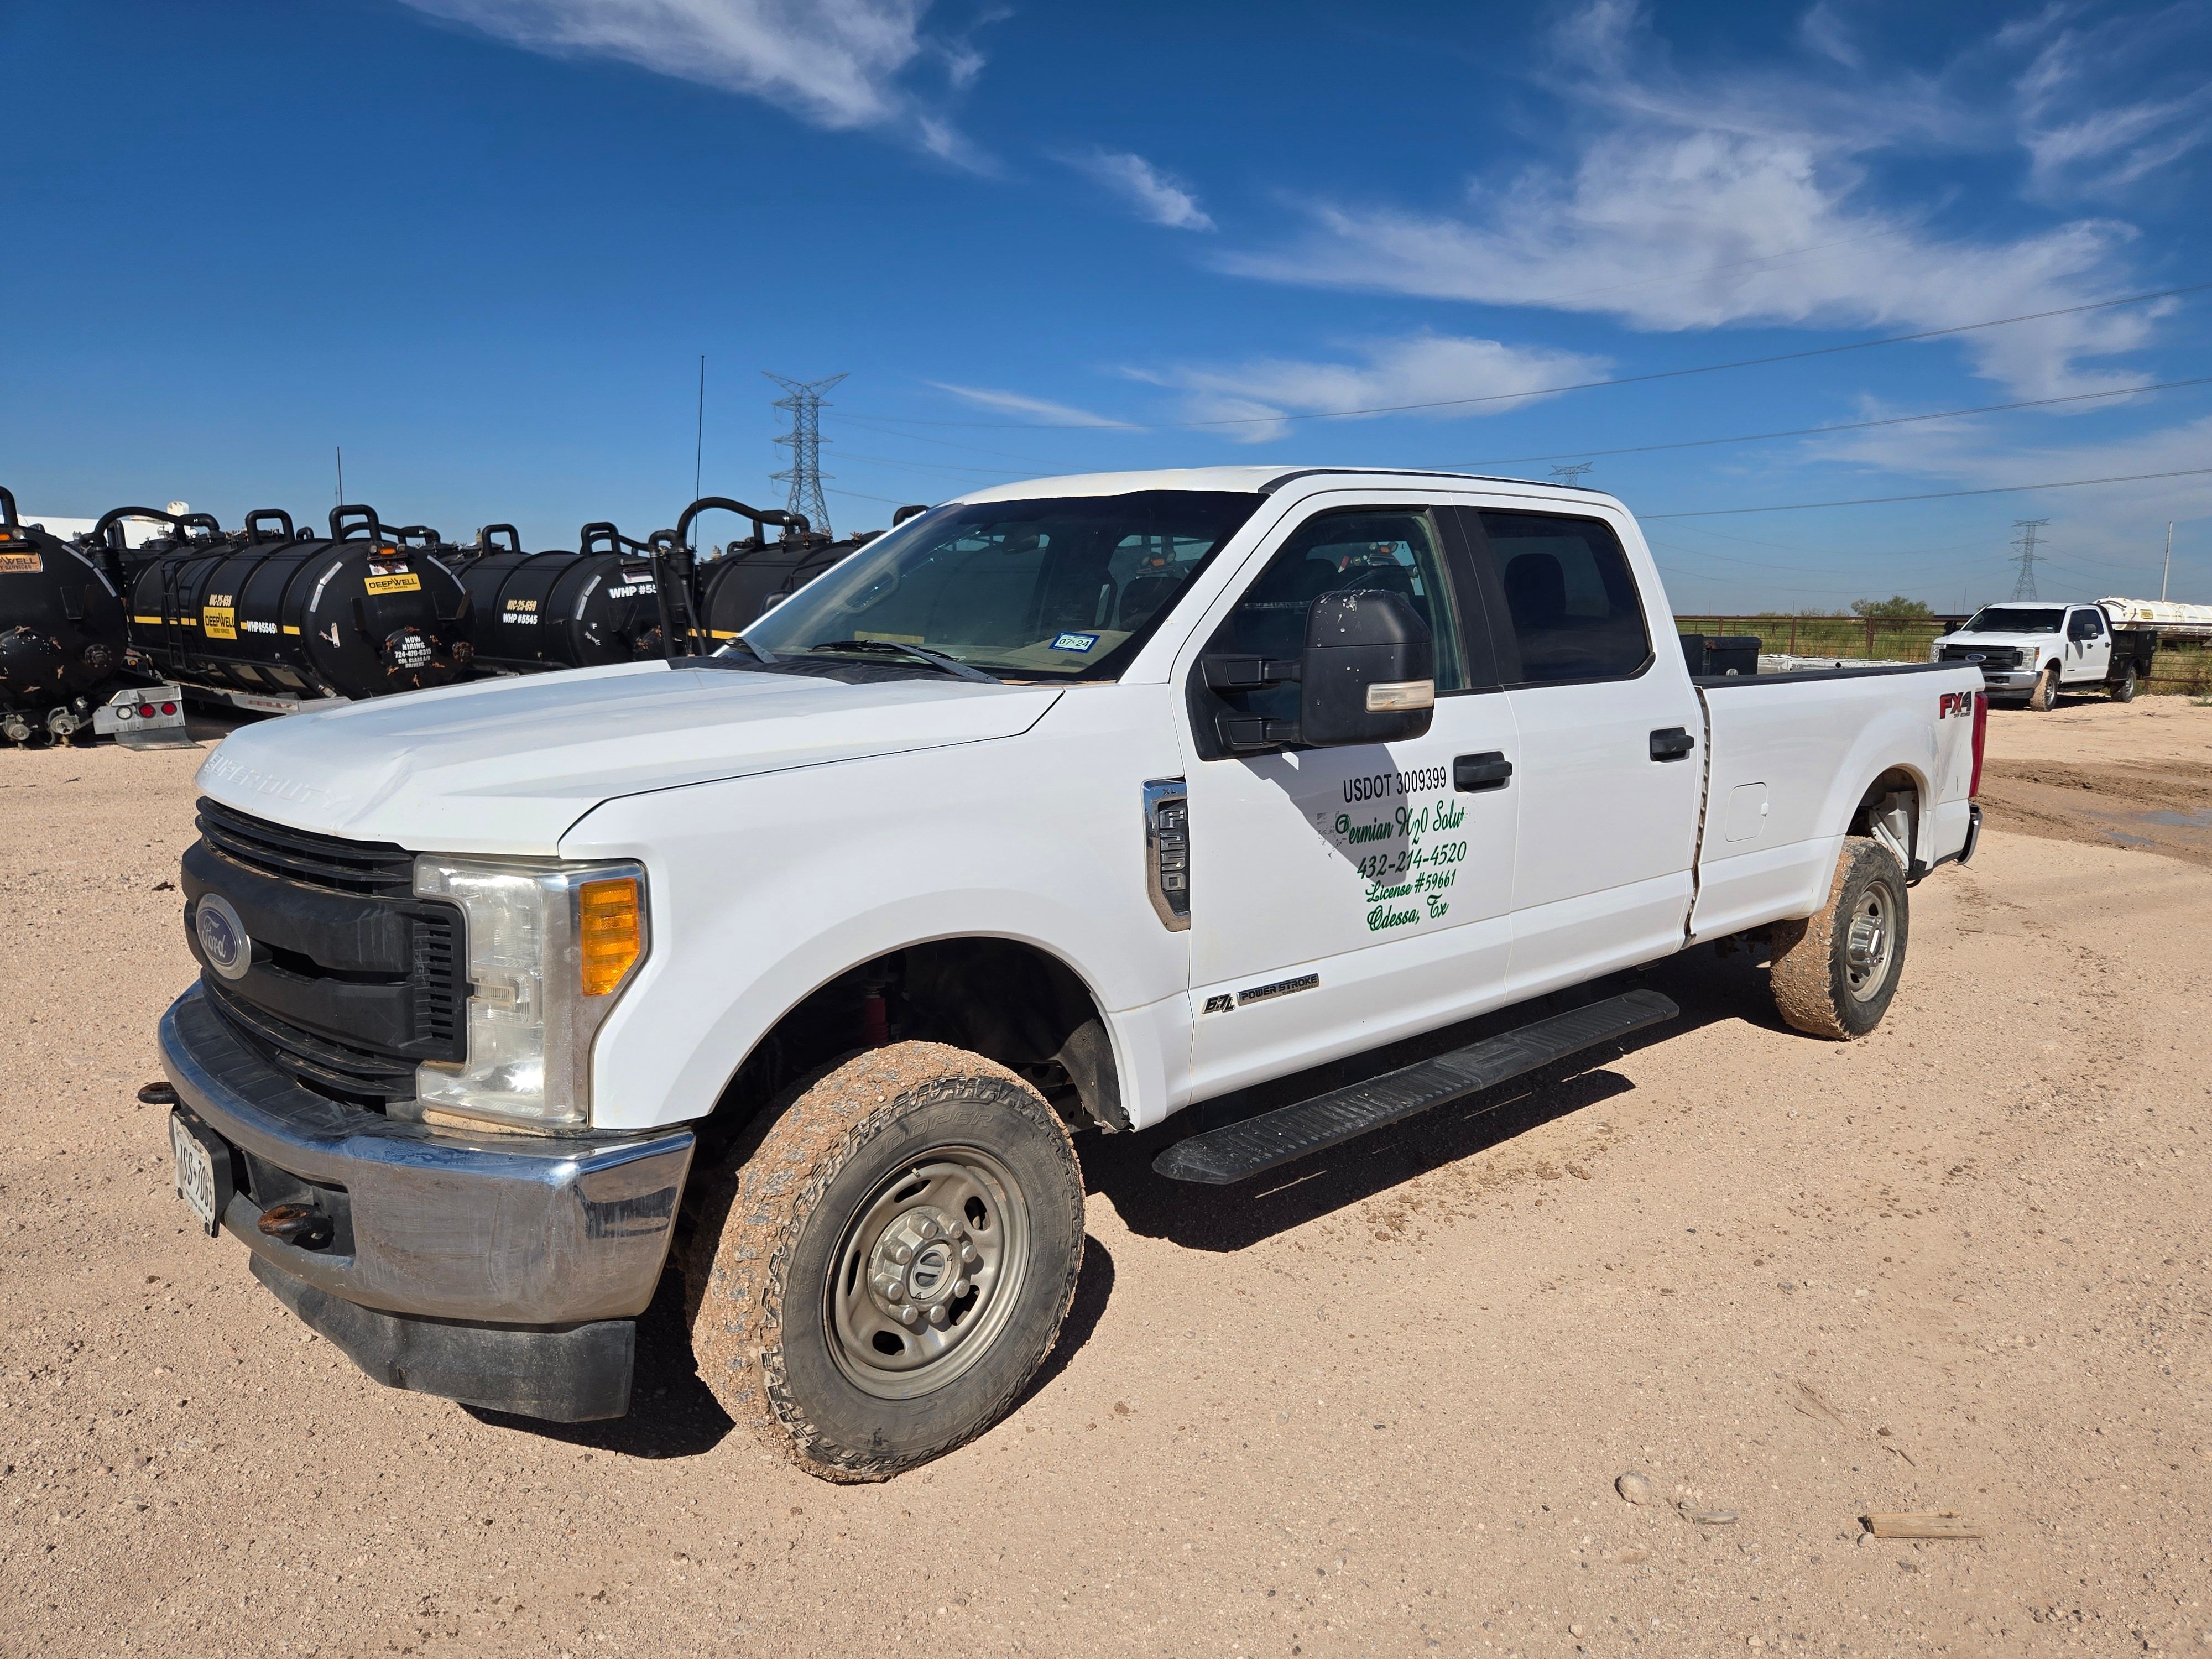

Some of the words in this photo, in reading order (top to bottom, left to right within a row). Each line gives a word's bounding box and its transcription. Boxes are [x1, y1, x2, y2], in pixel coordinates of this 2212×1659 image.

[369, 578, 418, 589] DEEPWELL
[609, 586, 637, 599] WHP
[205, 612, 235, 628] DEEPWELL
[503, 612, 518, 624] WHP
[518, 614, 538, 625] #5545
[402, 641, 425, 650] HIRING
[1939, 691, 1972, 719] FX4
[1343, 774, 1392, 803] USDOT
[1396, 766, 1447, 795] 3009399
[1357, 841, 1467, 879] 432-214-4520
[1365, 880, 1413, 902] License
[1415, 868, 1457, 894] #59661
[1367, 904, 1420, 932] Odessa,
[1427, 893, 1449, 919] Tx
[202, 915, 226, 958] Ford
[1241, 986, 1277, 1001] POWER
[1279, 975, 1317, 992] STROKE
[865, 1110, 994, 1171] COOPER
